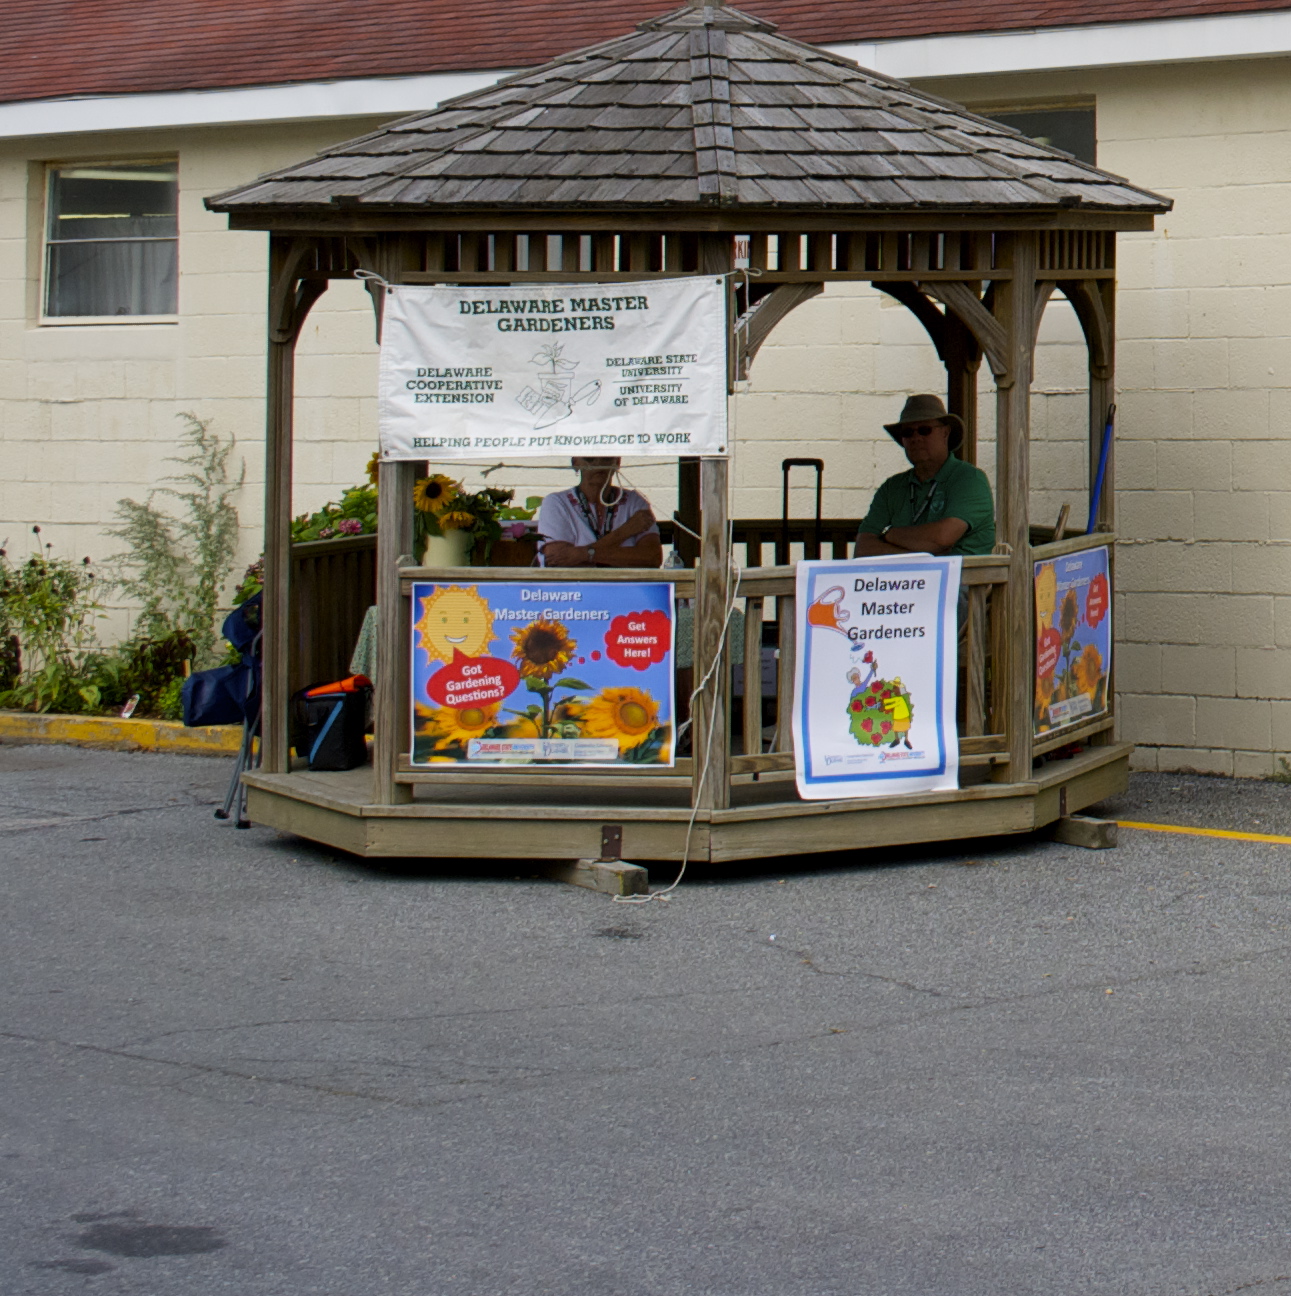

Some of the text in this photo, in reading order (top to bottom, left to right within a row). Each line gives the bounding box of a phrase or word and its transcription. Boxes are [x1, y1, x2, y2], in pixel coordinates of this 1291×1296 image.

[459, 295, 649, 315] DELAWARE MASTER
[497, 316, 615, 333] GARDENERS
[606, 354, 698, 367] DELAWARE STATE
[417, 367, 492, 378] DELAWARE
[621, 366, 683, 378] UNIVERSITY
[406, 379, 503, 391] COOPERATIVE
[619, 384, 682, 395] UNIVERSITY
[414, 393, 494, 404] EXTENSION
[614, 394, 689, 407] OF DELAWARE
[413, 432, 691, 448] HELPING PEOPLE PUT KNOWLEDGE TO WORK
[854, 577, 926, 593] Delaware
[521, 589, 582, 602] Delaware
[494, 608, 610, 621] Master Gardeners
[861, 602, 915, 617] Master
[628, 621, 646, 632] Get
[617, 634, 658, 644] Answers
[848, 625, 926, 642] Gardeners
[623, 647, 651, 658] Here!
[461, 664, 483, 676] Got
[446, 675, 502, 692] Gardening
[445, 686, 505, 705] Questions?
